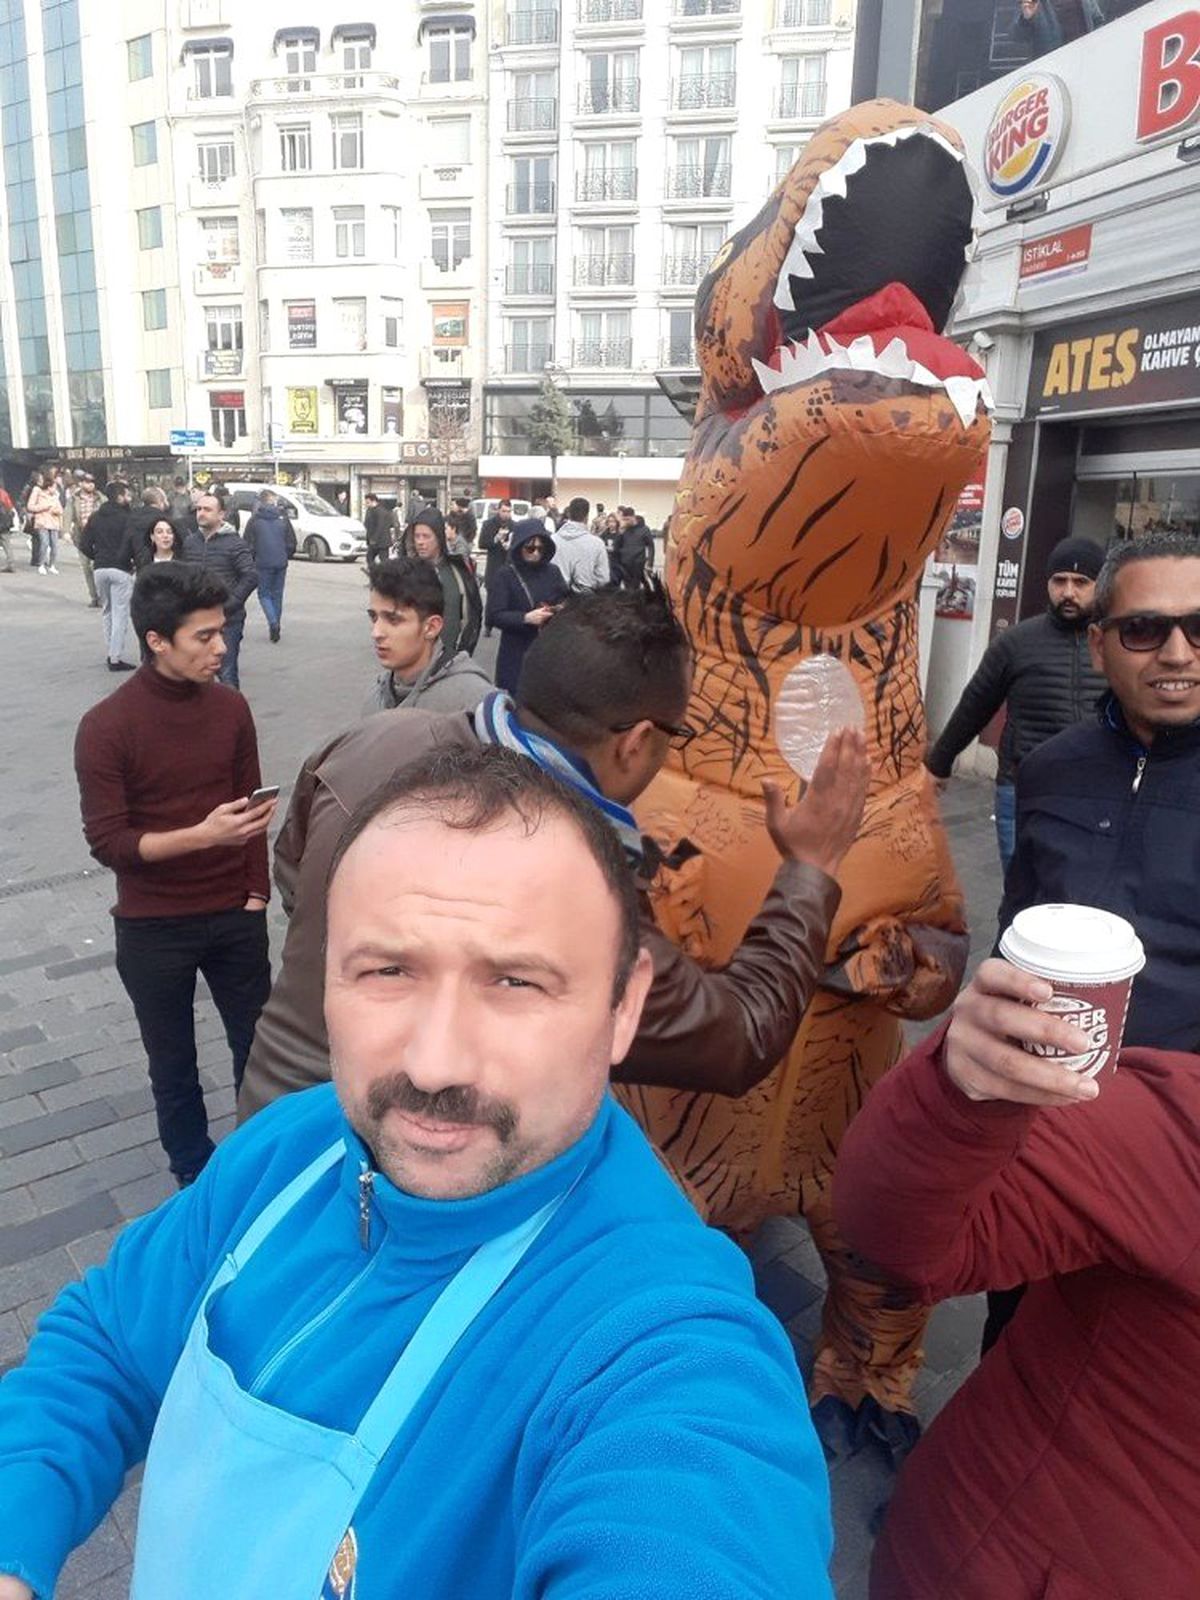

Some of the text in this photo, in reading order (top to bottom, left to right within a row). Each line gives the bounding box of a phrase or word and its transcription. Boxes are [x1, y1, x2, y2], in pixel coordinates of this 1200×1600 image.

[988, 87, 1049, 153] BURGER
[989, 107, 1049, 180] KING
[1140, 346, 1191, 372] KAHVE
[1143, 325, 1200, 351] OLMAYAN
